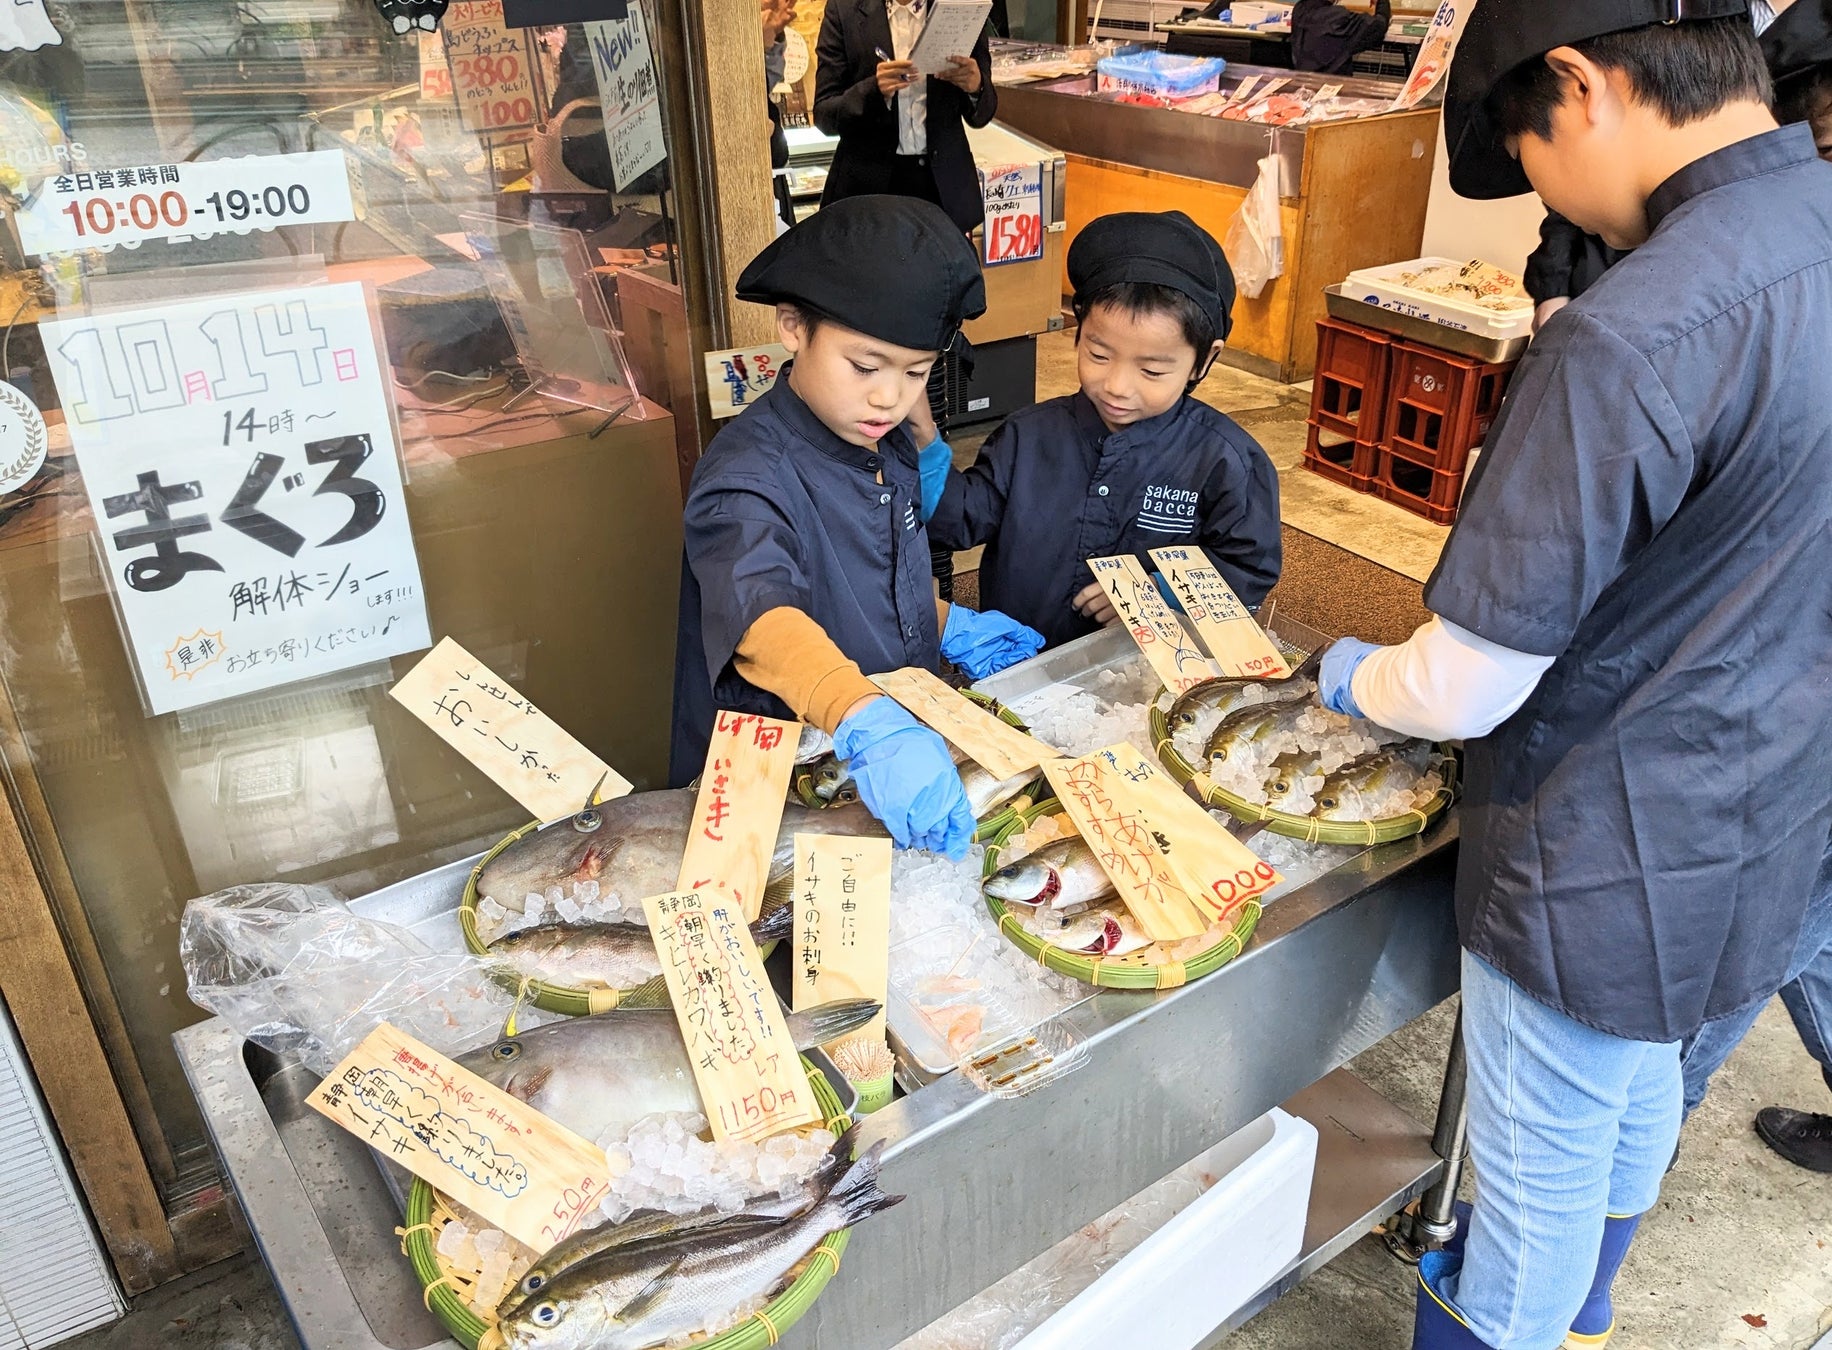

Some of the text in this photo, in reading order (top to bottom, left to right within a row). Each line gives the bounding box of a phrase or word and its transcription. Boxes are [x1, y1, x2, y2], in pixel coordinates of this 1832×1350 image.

[593, 10, 641, 82] New!!
[53, 165, 181, 194] 全日営業時間
[58, 299, 359, 425] 10月14日
[102, 432, 387, 593] まぐろ
[1143, 497, 1196, 517] bacca
[1145, 484, 1200, 504] sakana
[229, 562, 390, 622] 解体ショー
[1111, 578, 1142, 628] イサキ
[1171, 567, 1199, 604] イサキ
[177, 638, 216, 671] 是非
[456, 670, 538, 715] しんせんで
[432, 688, 561, 783] おいしかった
[704, 758, 732, 842] いさき
[658, 893, 703, 916] 静岡
[1201, 861, 1276, 911] 1000
[801, 851, 822, 986] イサキのお刺身
[347, 1103, 416, 1154] イサキ
[719, 1087, 798, 1132] 1150円
[541, 1176, 596, 1242] 250円
